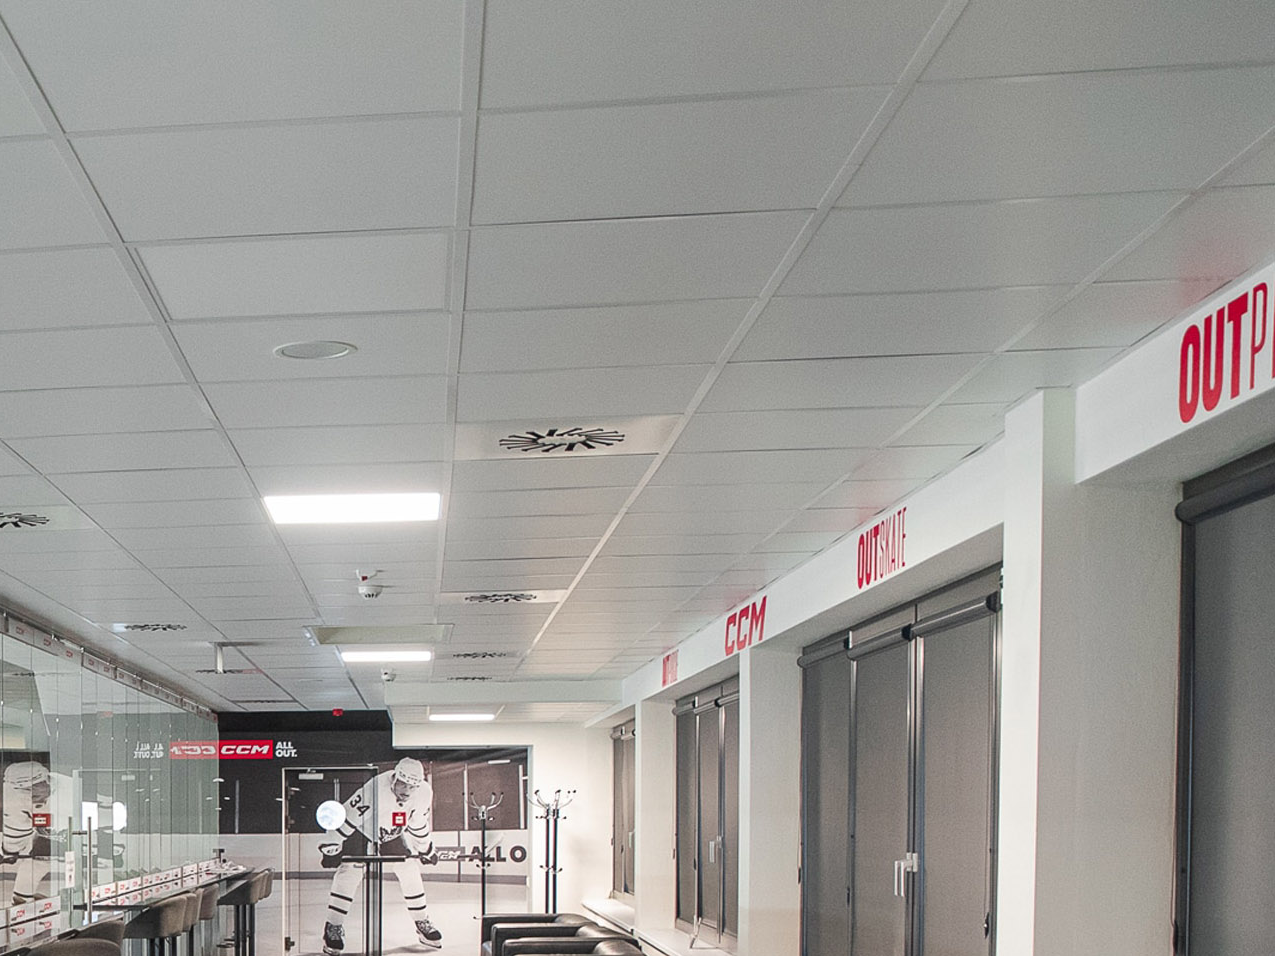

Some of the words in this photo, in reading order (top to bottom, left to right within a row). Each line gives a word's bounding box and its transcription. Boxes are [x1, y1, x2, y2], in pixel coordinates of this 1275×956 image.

[1178, 282, 1275, 424] OUTP
[857, 506, 907, 590] OUTSKATE
[724, 595, 767, 656] CCM
[220, 745, 271, 755] CCM
[275, 741, 294, 750] ALL
[275, 750, 298, 758] OUT.
[349, 794, 371, 817] 34
